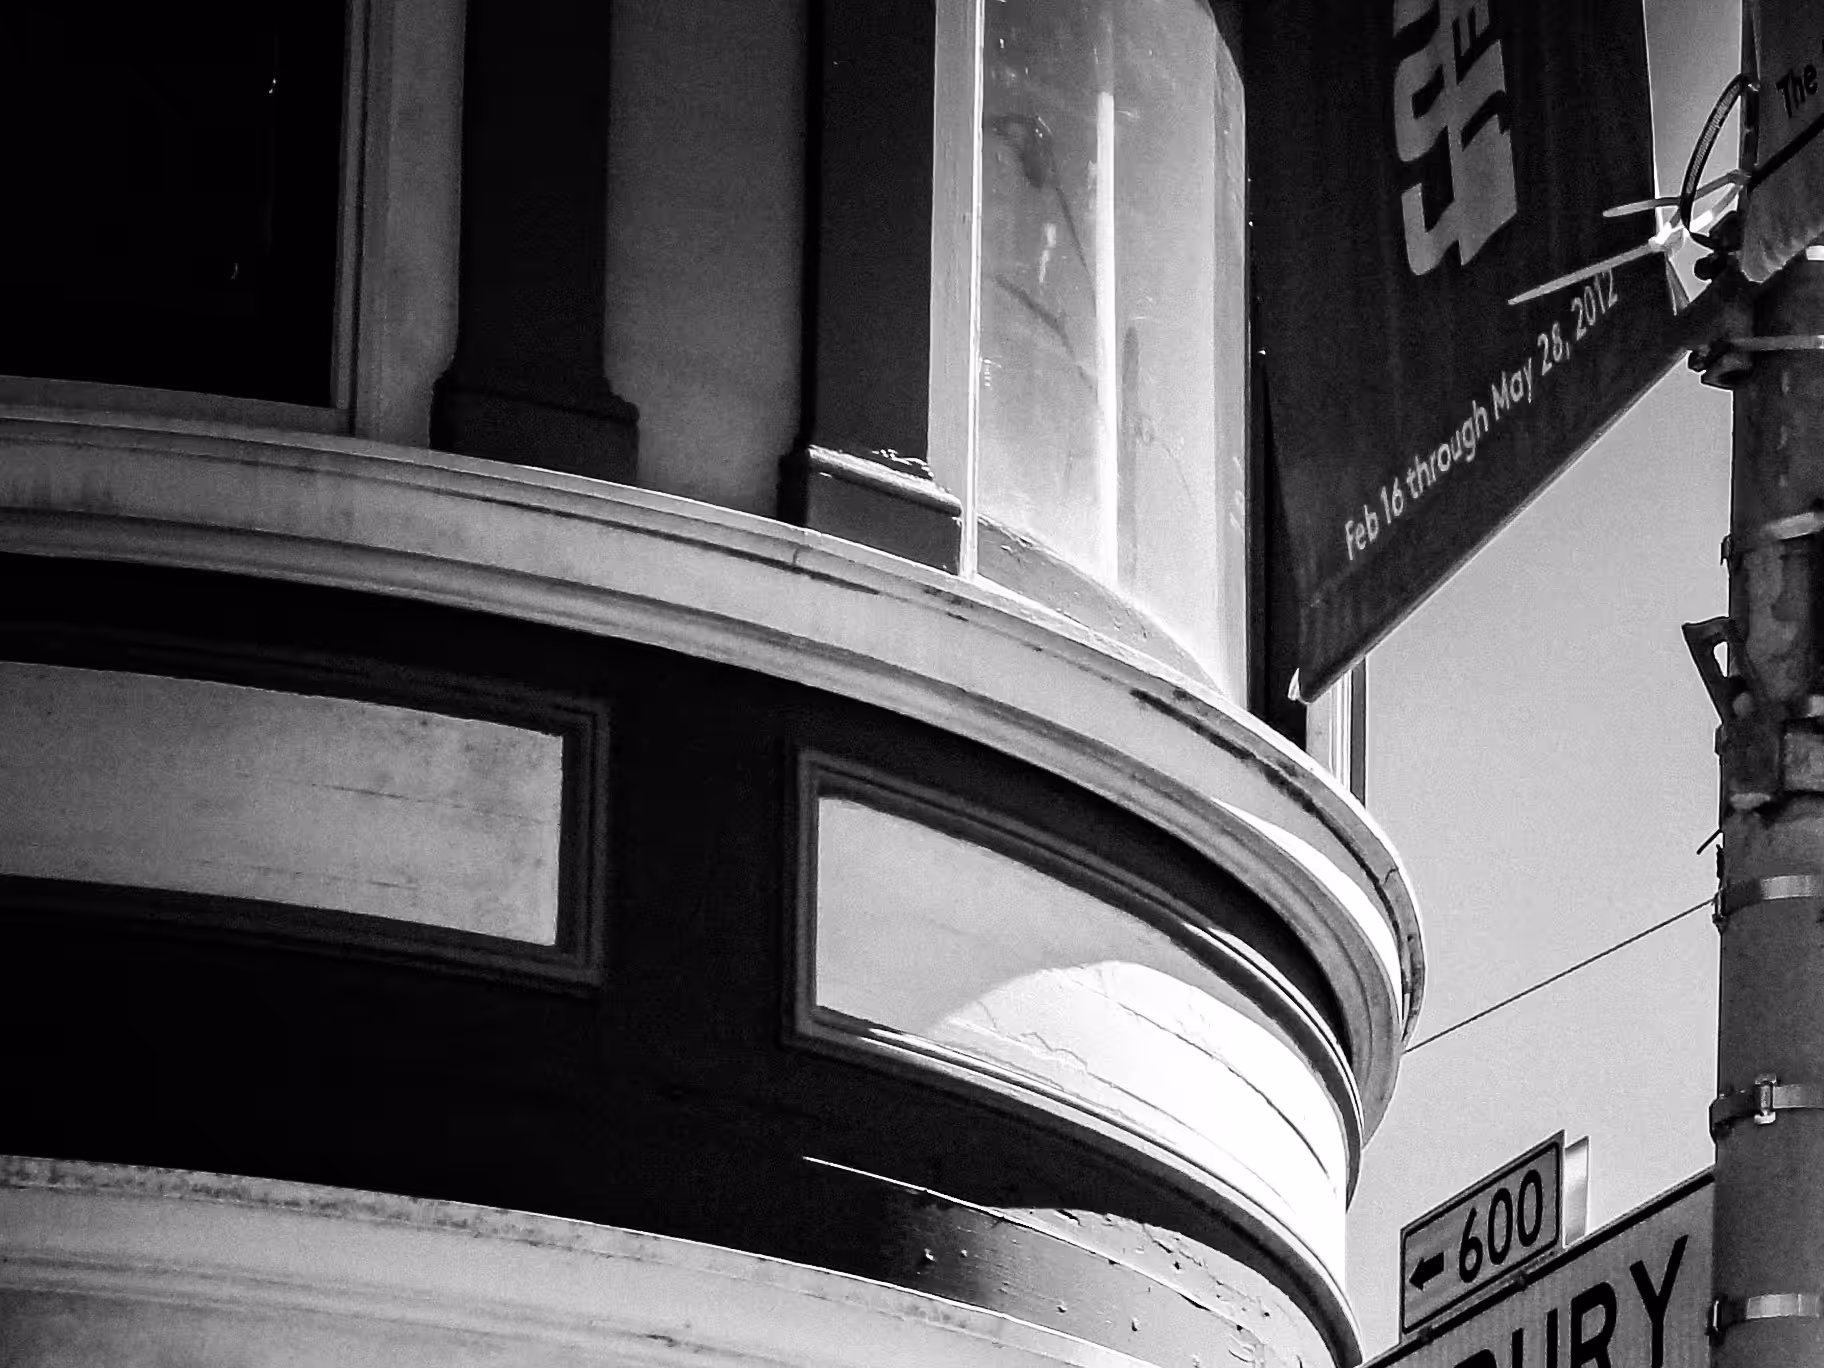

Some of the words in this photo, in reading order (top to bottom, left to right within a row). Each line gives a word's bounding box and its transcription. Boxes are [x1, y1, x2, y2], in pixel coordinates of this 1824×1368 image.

[1776, 65, 1818, 119] The
[1344, 504, 1379, 561] Feb
[1380, 477, 1405, 524] 16
[1406, 400, 1489, 499] through
[1491, 357, 1533, 422] May
[1538, 320, 1570, 377] 28,
[1570, 266, 1618, 341] 2012
[1458, 1168, 1544, 1284] 600
